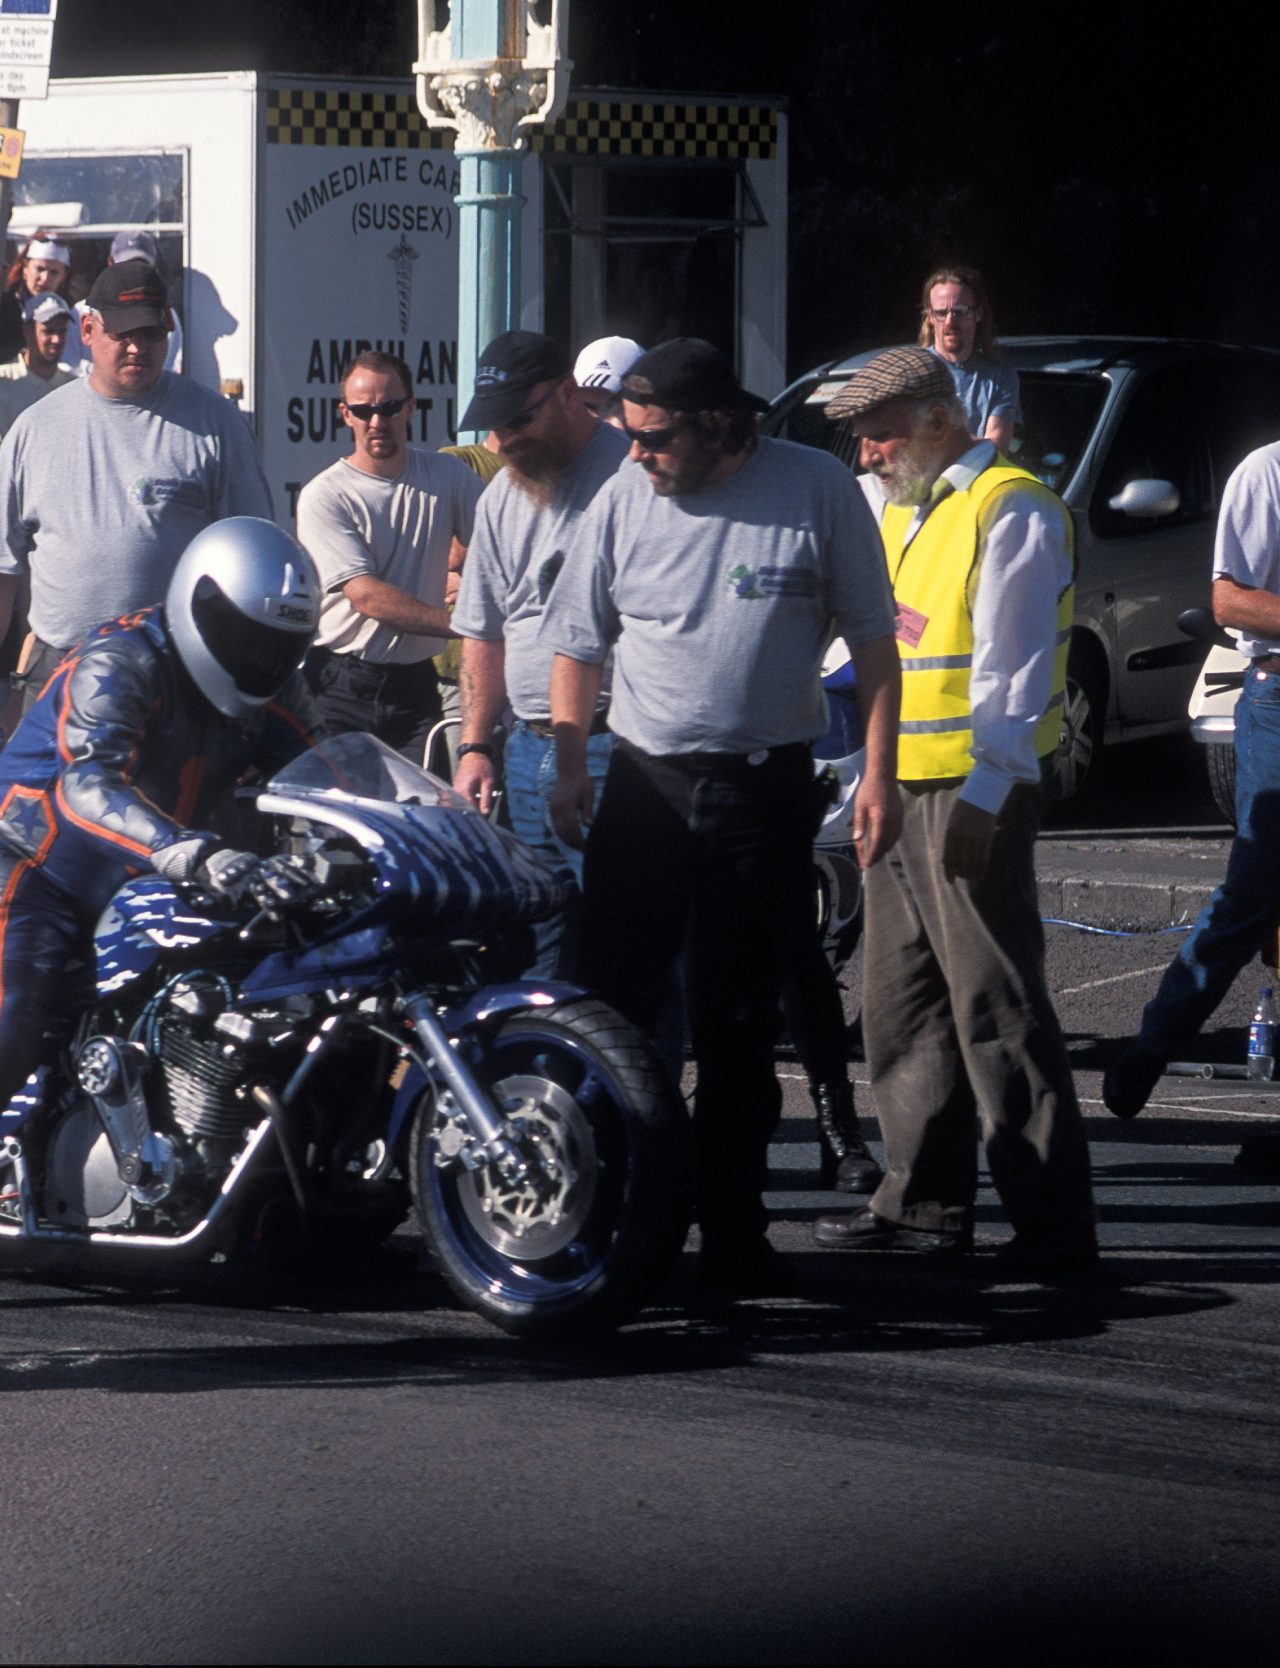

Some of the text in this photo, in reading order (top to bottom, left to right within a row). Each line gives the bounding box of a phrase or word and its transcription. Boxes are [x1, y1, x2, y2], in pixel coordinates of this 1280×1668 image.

[1, 26, 10, 34] at
[14, 26, 49, 36] machine
[10, 38, 36, 48] ticket
[8, 71, 24, 82] day
[286, 156, 461, 230] IMMEDIATE CAR
[352, 202, 452, 239] (SUSSEX)
